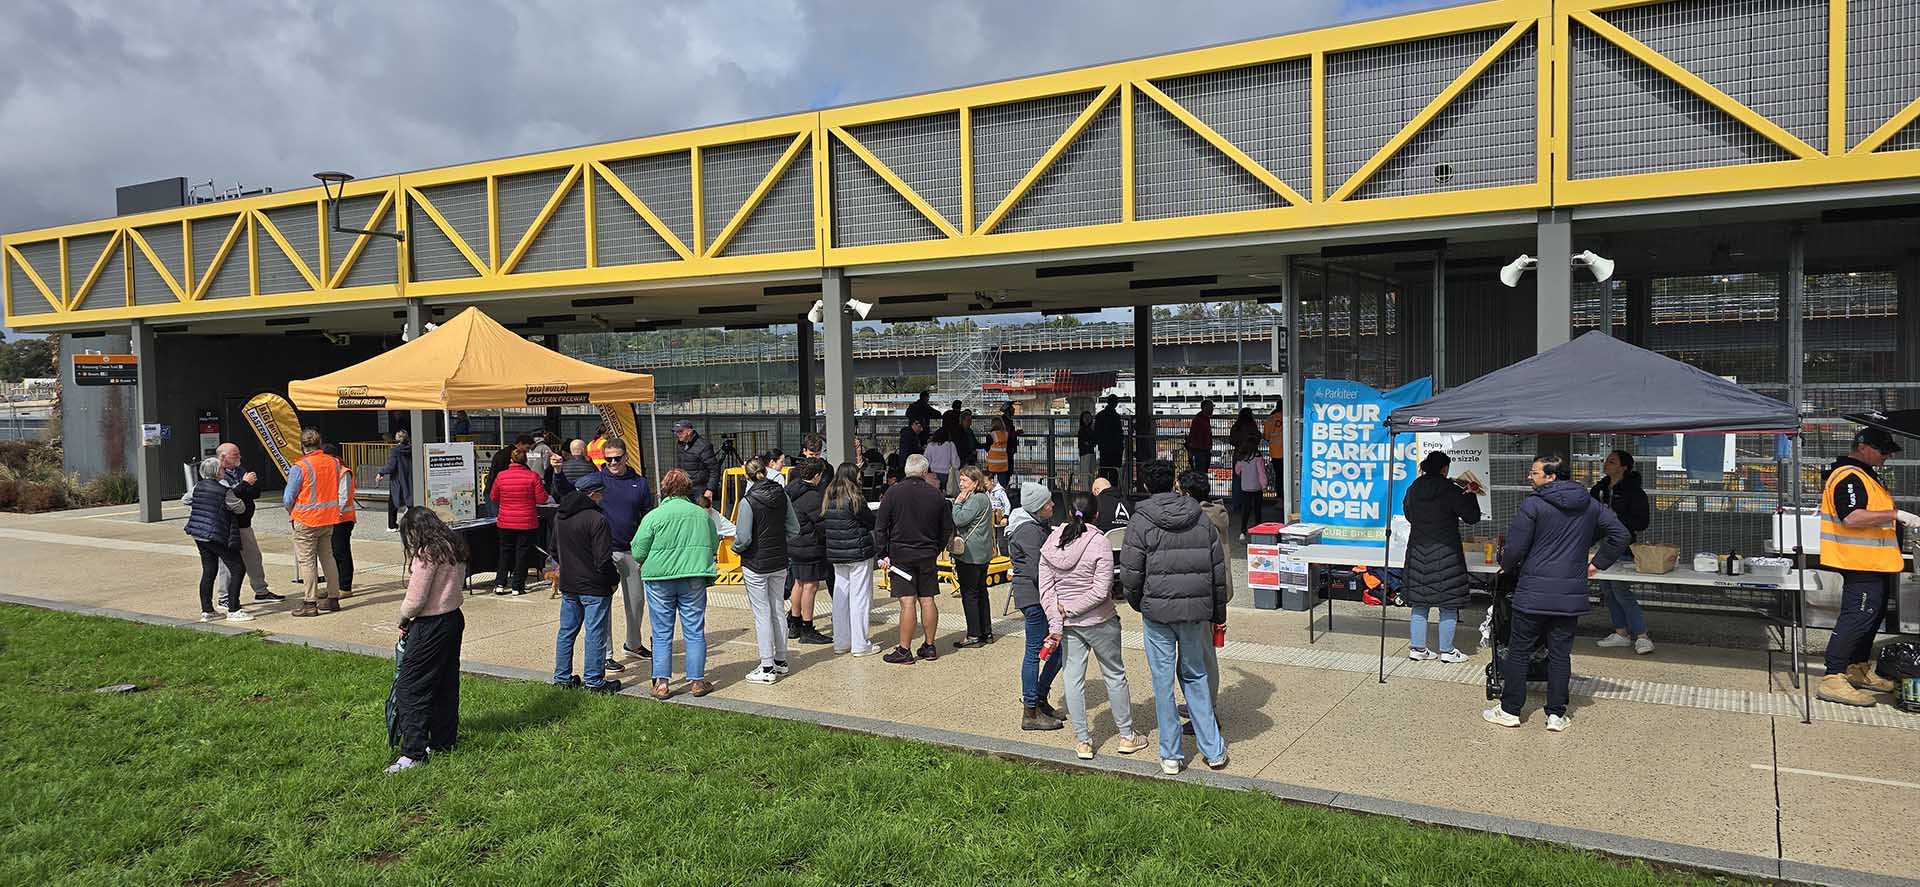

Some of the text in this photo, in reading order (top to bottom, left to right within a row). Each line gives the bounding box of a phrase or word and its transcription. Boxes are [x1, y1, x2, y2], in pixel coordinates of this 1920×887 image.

[544, 385, 566, 393] BUILD
[1324, 388, 1359, 400] Parkiteer
[259, 405, 270, 422] BIG
[1312, 403, 1381, 422] YOUR
[249, 410, 270, 443] EASTERN
[1312, 423, 1374, 441] BEST
[1423, 441, 1443, 449] Enjoy
[1311, 461, 1407, 481] SPOT IS
[1311, 480, 1374, 500] NOW
[1310, 499, 1380, 519] OPEN
[1350, 528, 1373, 538] BIKE
